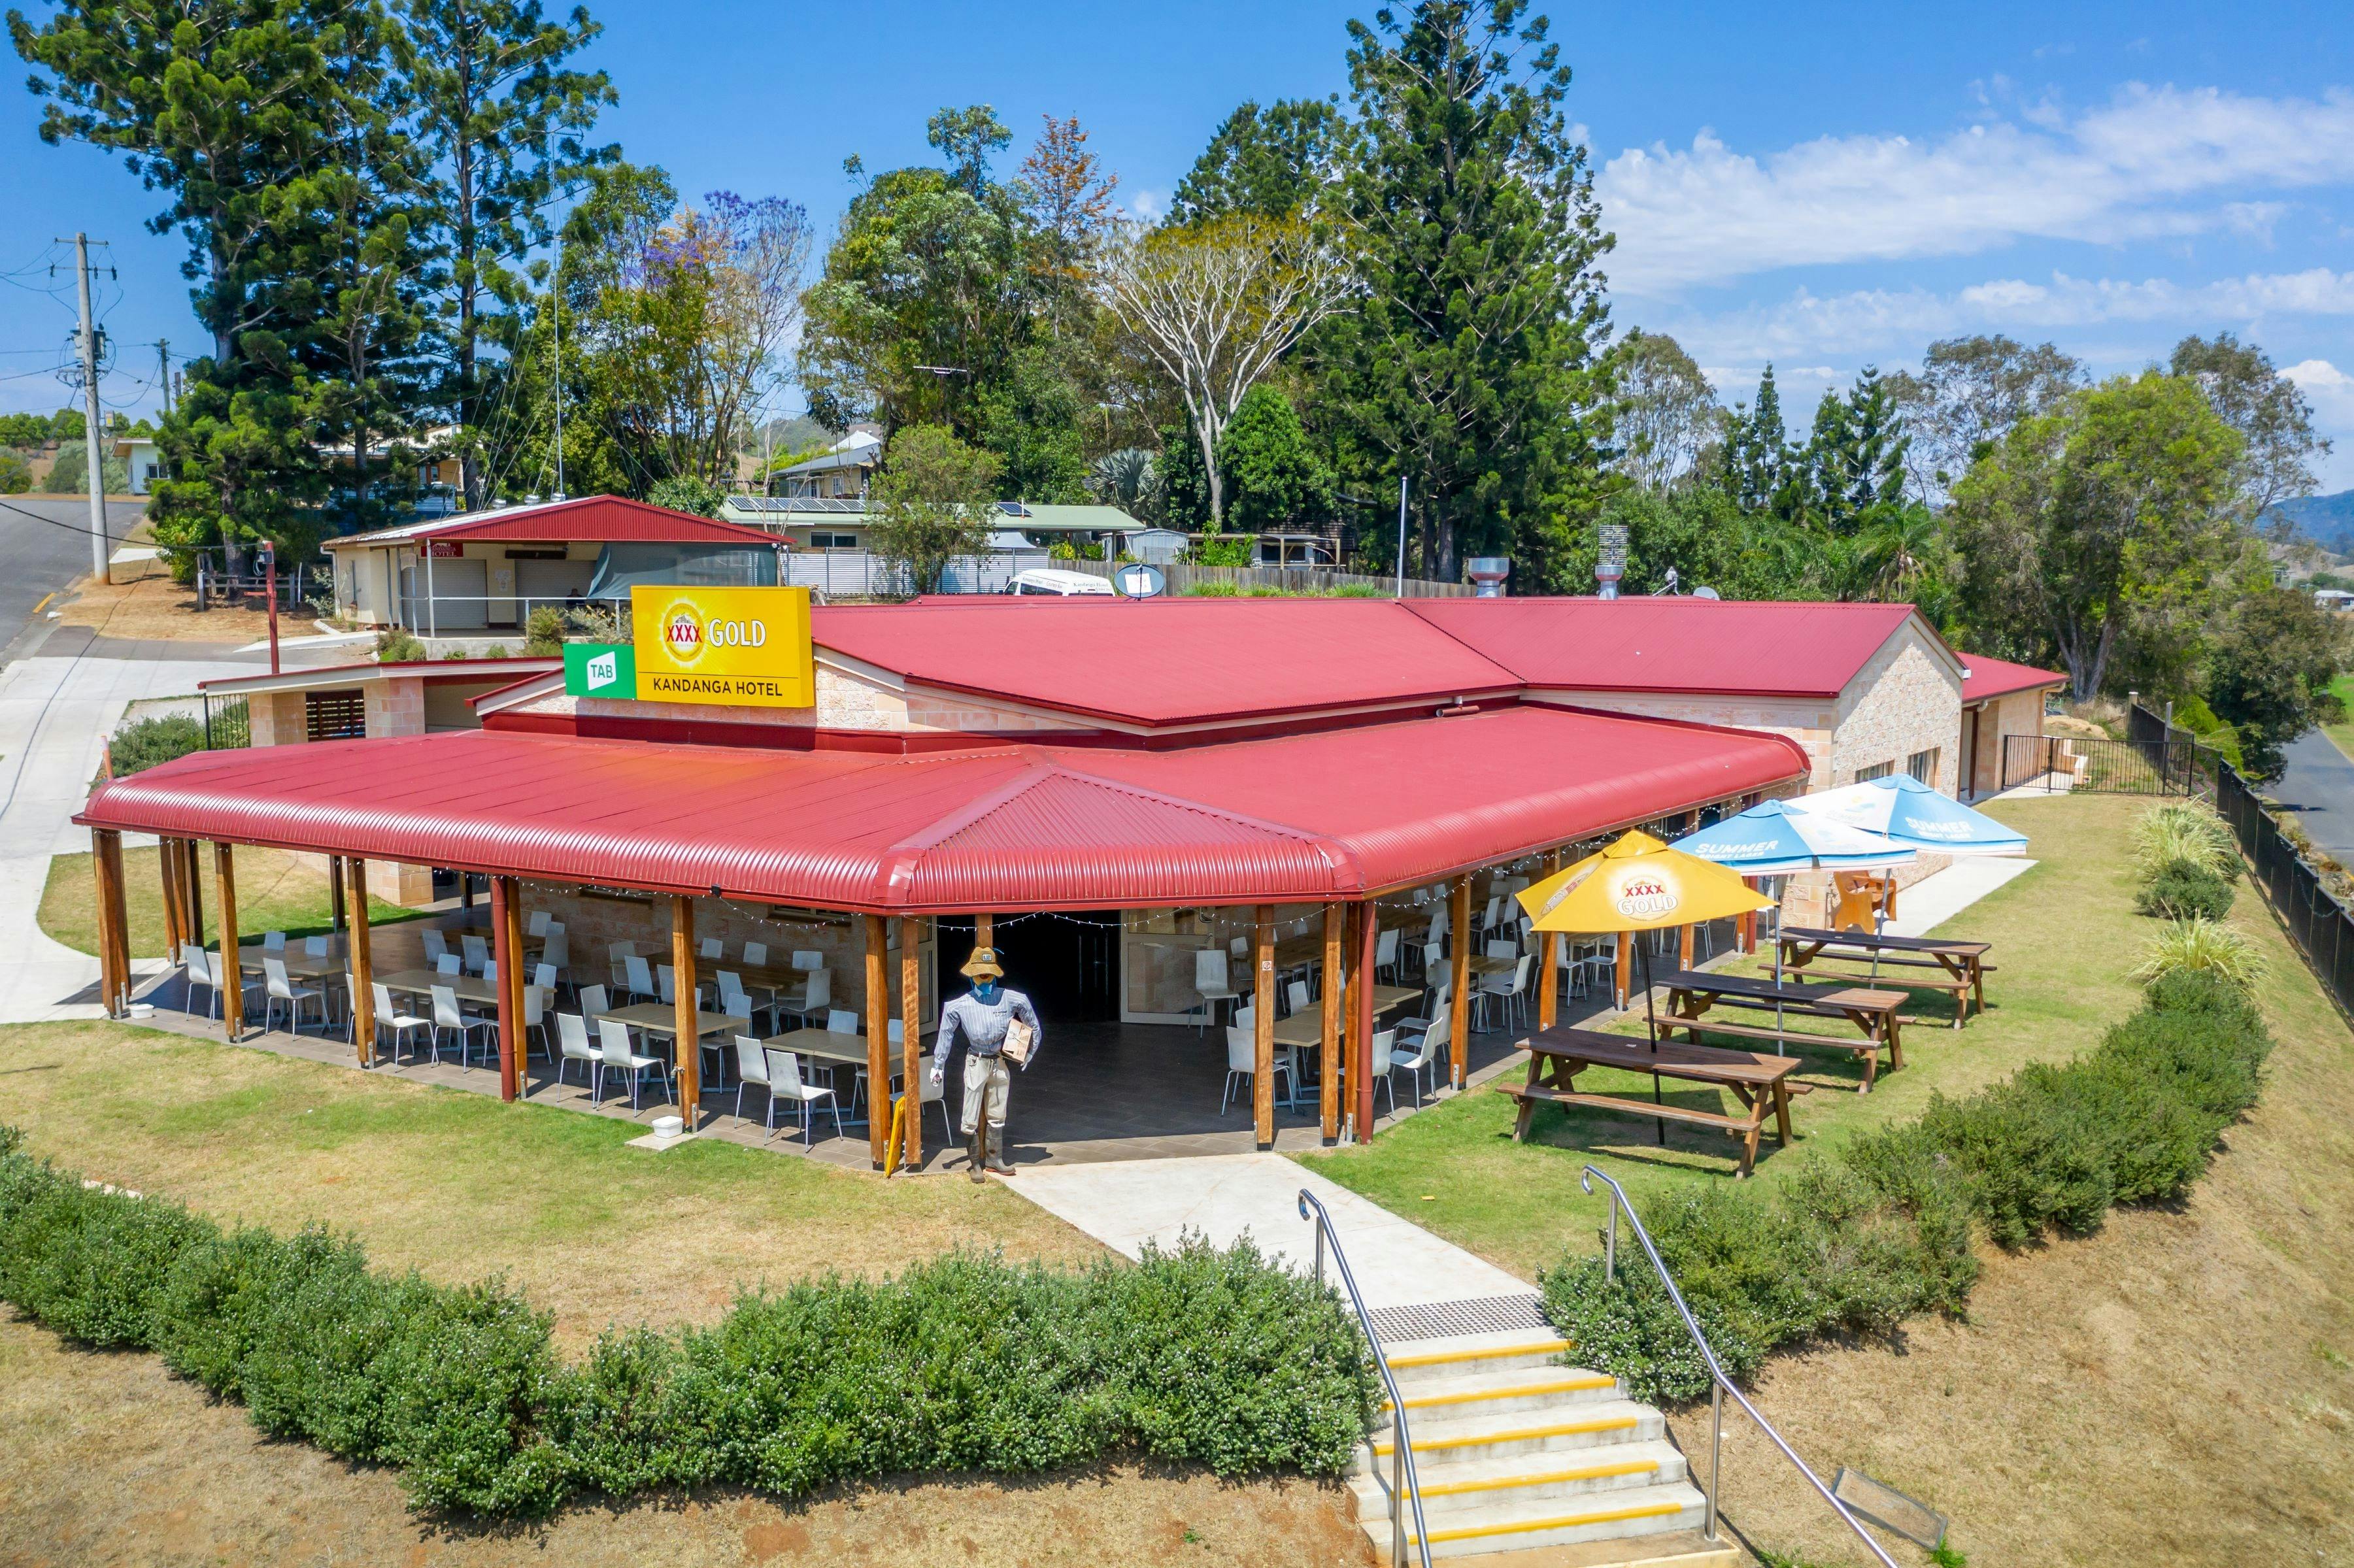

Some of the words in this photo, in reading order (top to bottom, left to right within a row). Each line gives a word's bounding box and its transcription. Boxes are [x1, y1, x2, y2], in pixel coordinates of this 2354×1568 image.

[667, 624, 703, 642] XXXX
[709, 618, 766, 648] GOLD
[590, 665, 613, 678] TAB
[654, 678, 731, 693] KANDANGA
[736, 682, 782, 696] HOTEL
[1905, 816, 1974, 833] SUMMER
[1695, 839, 1778, 854] SUMMER
[1625, 885, 1665, 897] XXXX
[1617, 894, 1678, 916] GOLD
